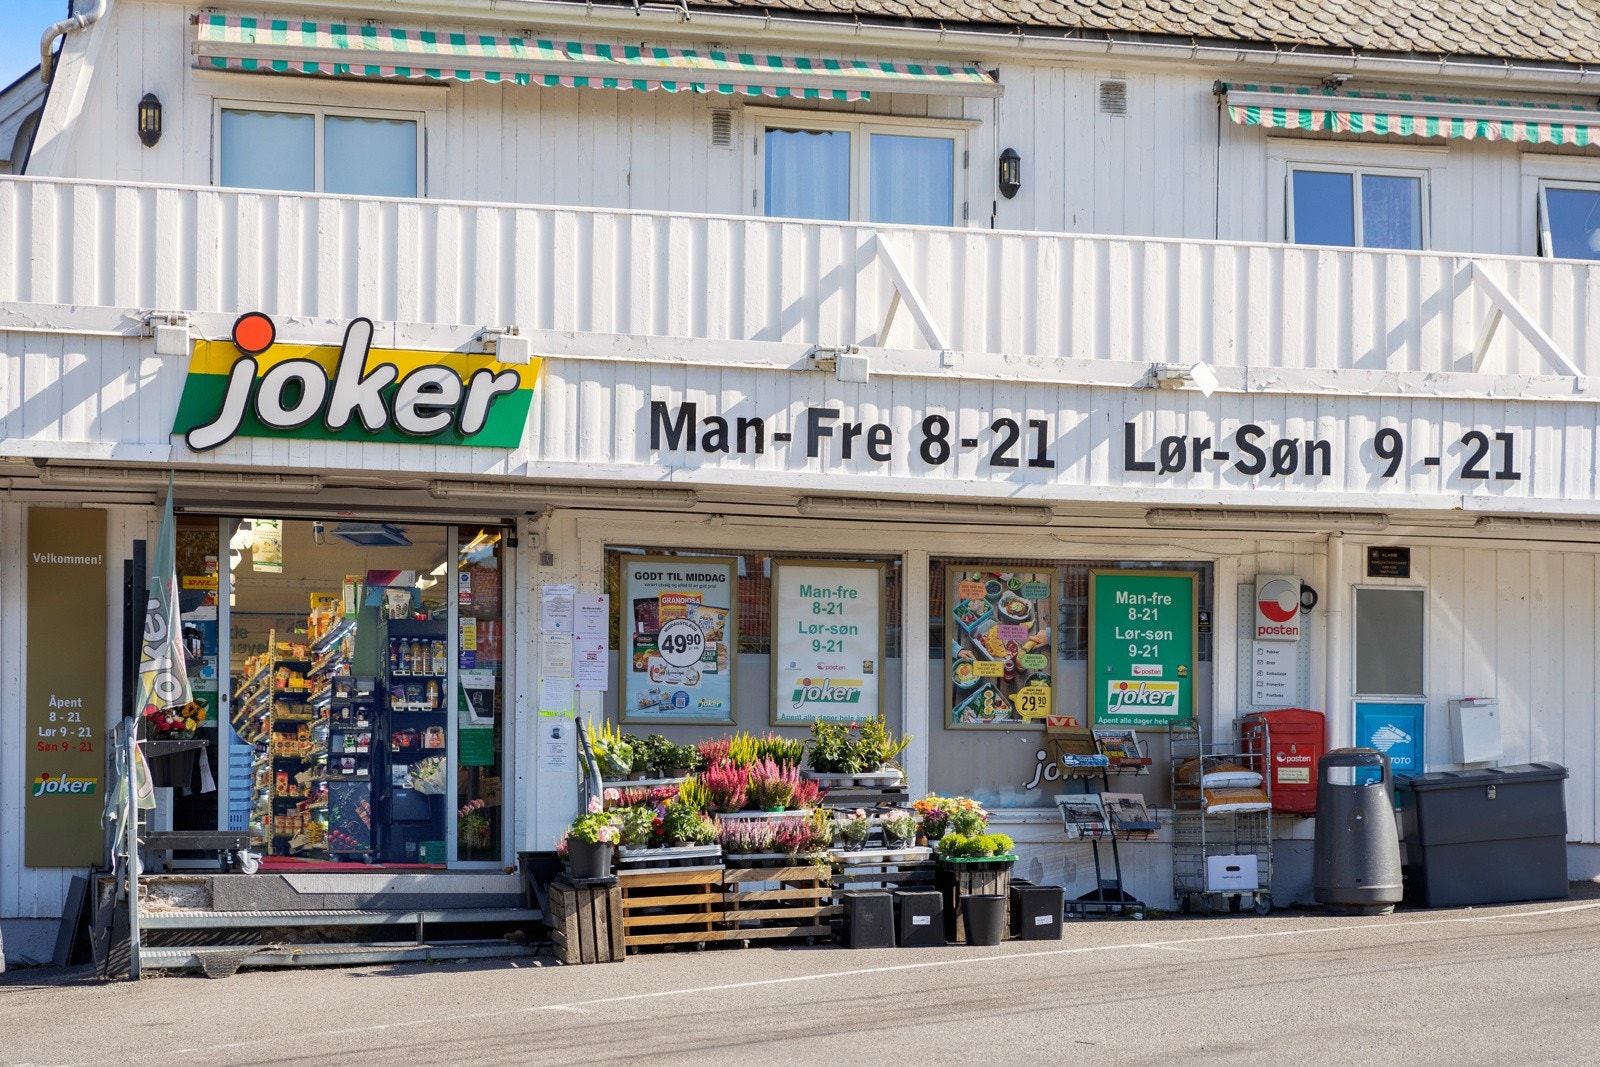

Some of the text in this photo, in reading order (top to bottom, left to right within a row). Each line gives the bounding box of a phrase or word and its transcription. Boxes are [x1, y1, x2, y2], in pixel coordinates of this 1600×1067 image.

[185, 311, 521, 453] joker
[1124, 422, 1331, 477] Lør-Søn
[33, 553, 102, 564] Velkommen!
[634, 572, 726, 582] GODT TIL MIDDAG
[800, 585, 858, 599] Man-fre
[1116, 591, 1172, 605] Man-fre
[812, 602, 843, 615] 8-21
[1128, 608, 1158, 621] 8-21
[798, 621, 858, 635] Lør-søn
[1115, 627, 1173, 640] Lør-søn
[1258, 625, 1298, 636] posten
[812, 639, 843, 652] 9-21
[1128, 644, 1158, 657] 9-21
[793, 678, 857, 709] joker
[1110, 682, 1172, 712] joker
[48, 694, 82, 709] Åpent
[49, 712, 56, 722] 8
[67, 712, 81, 722] 21
[1098, 715, 1119, 725] Åpent
[38, 726, 56, 737] Lør
[60, 727, 67, 737] 9
[78, 727, 92, 737] 21
[37, 741, 58, 752] Søn
[61, 742, 69, 751] 9
[80, 742, 93, 752] 21
[1286, 755, 1311, 763] posten
[34, 772, 92, 797] joker
